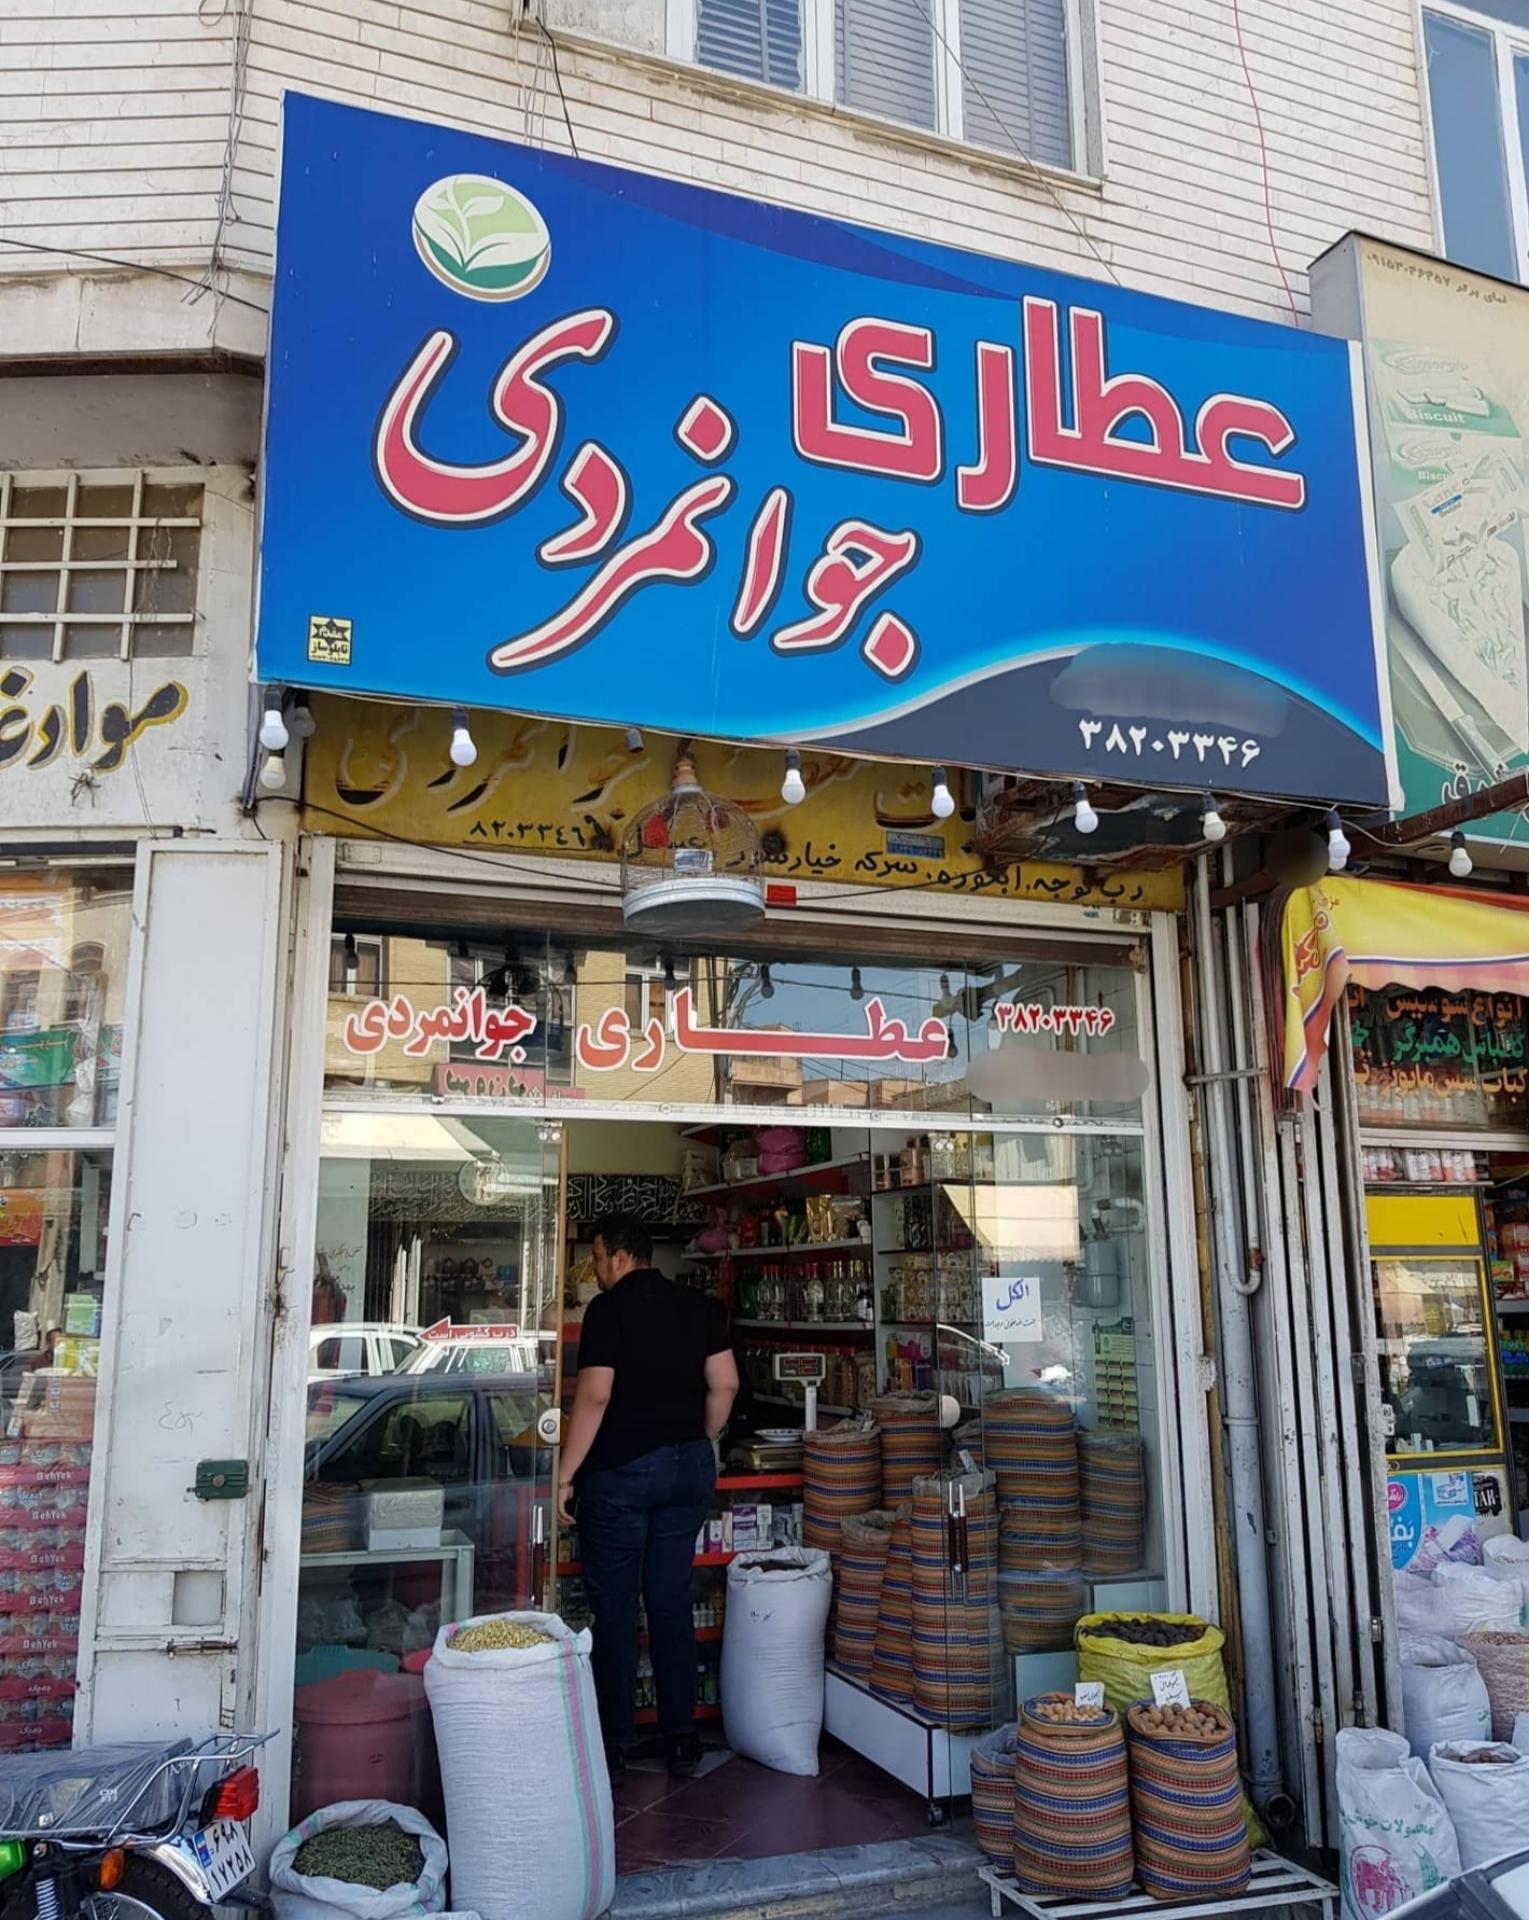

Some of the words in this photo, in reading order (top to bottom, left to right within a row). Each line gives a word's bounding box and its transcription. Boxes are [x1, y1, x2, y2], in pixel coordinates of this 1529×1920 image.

[790, 293, 1308, 513] عطاری
[372, 306, 918, 680] جوانمردی
[26, 669, 190, 775] مواد
[1078, 718, 1262, 768] ۳۸۲۰۳۳۴۶
[343, 985, 537, 1064] جوانمردی
[576, 986, 950, 1072] عطاری
[994, 1001, 1116, 1037] ۳۸۲۰۳۳۴۶
[995, 1278, 1029, 1312] الکل
[428, 1328, 453, 1340] است
[492, 1327, 516, 1340] درب
